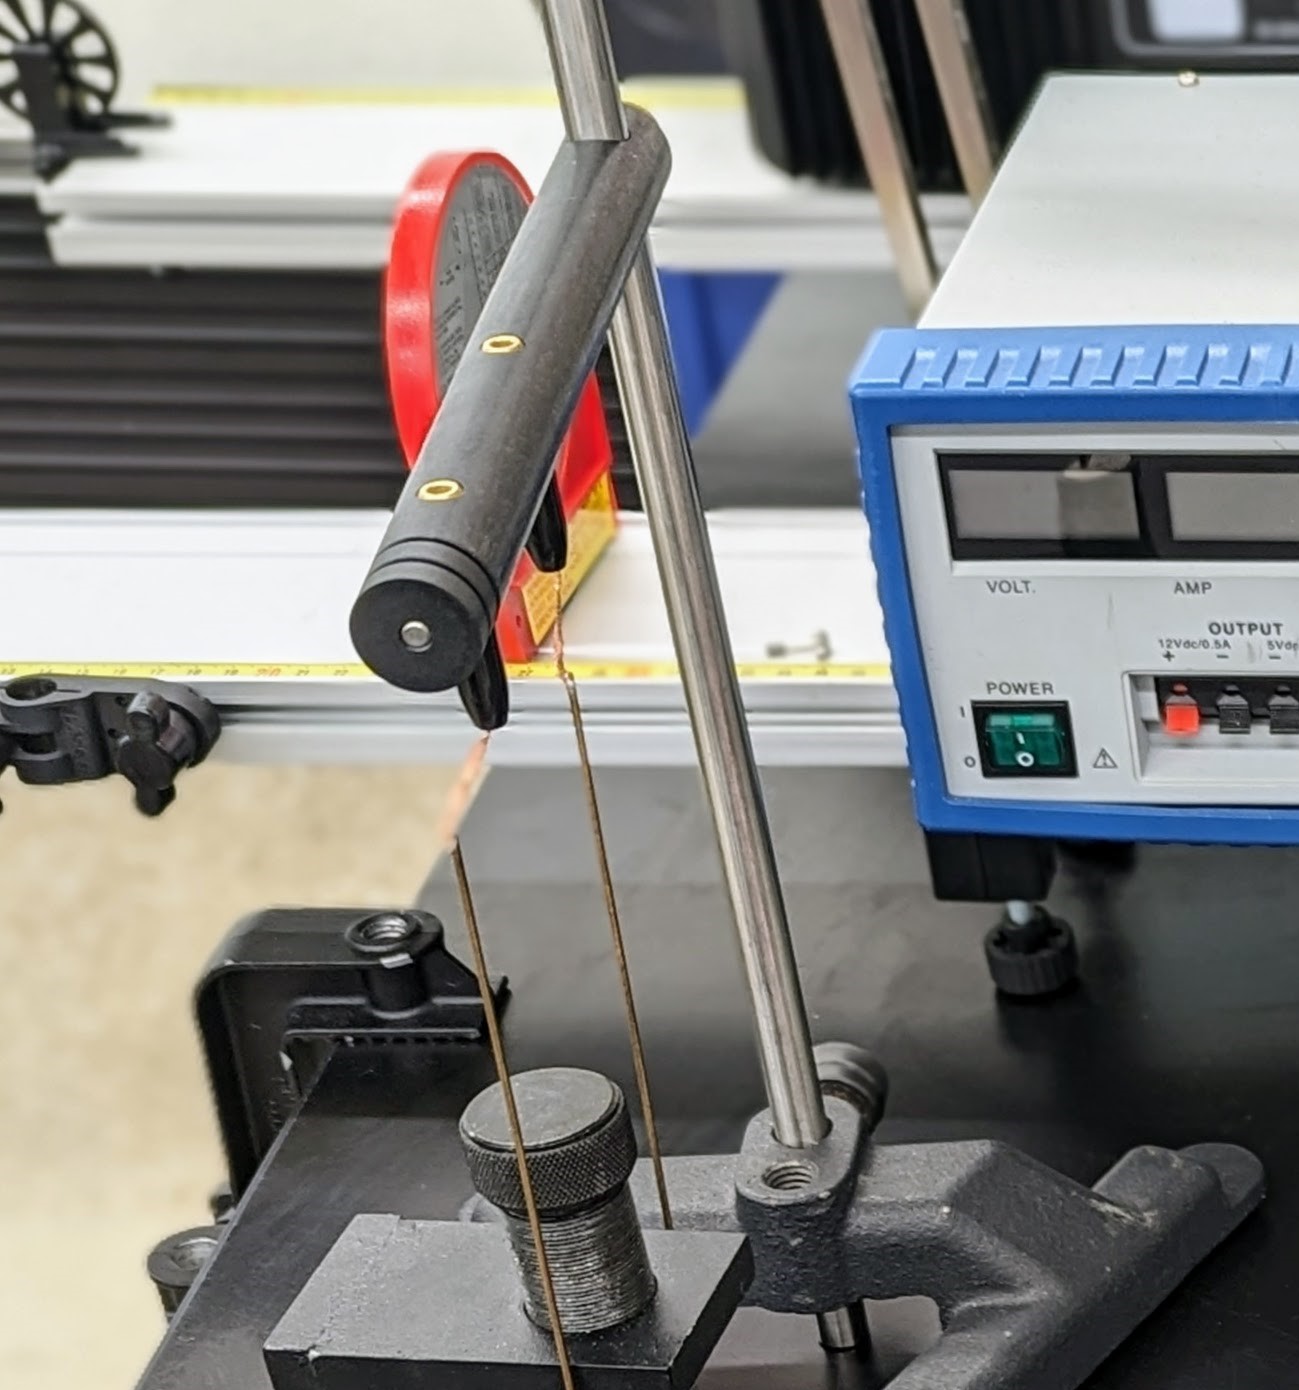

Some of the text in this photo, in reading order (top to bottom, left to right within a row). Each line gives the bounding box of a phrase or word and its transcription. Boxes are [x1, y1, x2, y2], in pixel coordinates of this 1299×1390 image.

[986, 580, 1036, 595] VOLT.
[1173, 582, 1213, 595] AMP
[1208, 622, 1284, 637] OUTPUT
[986, 681, 1054, 696] POWER
